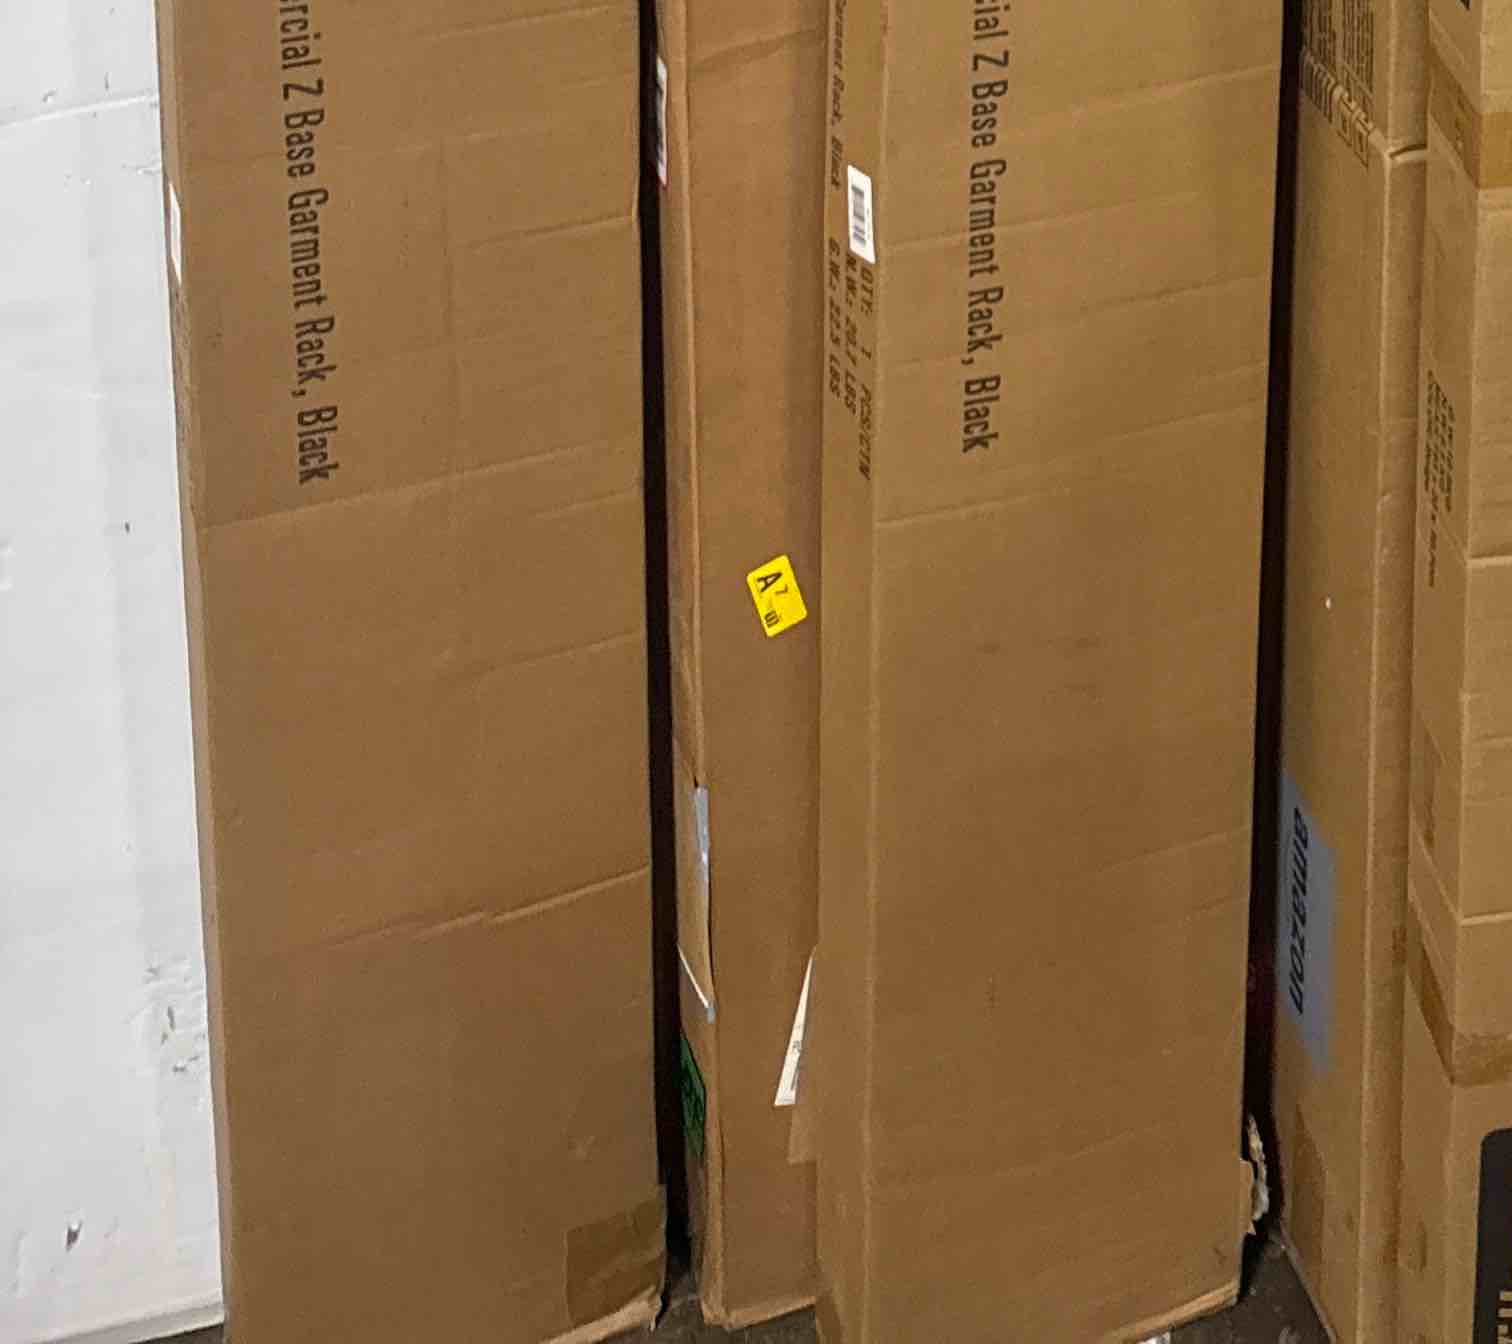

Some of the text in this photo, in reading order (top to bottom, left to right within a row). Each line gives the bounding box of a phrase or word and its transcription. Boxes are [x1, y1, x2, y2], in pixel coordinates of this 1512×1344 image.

[282, 80, 324, 100] Z
[972, 50, 1008, 72] Z
[284, 108, 325, 178] Base
[971, 80, 1008, 149] Base
[831, 135, 842, 190] Black
[288, 188, 328, 308] Garment
[969, 158, 1007, 278] Garment
[291, 315, 337, 397] Rack,
[961, 286, 1004, 366] Rack,
[297, 405, 339, 485] Black
[962, 375, 1001, 454] Black
[1288, 807, 1308, 1015] amazon
